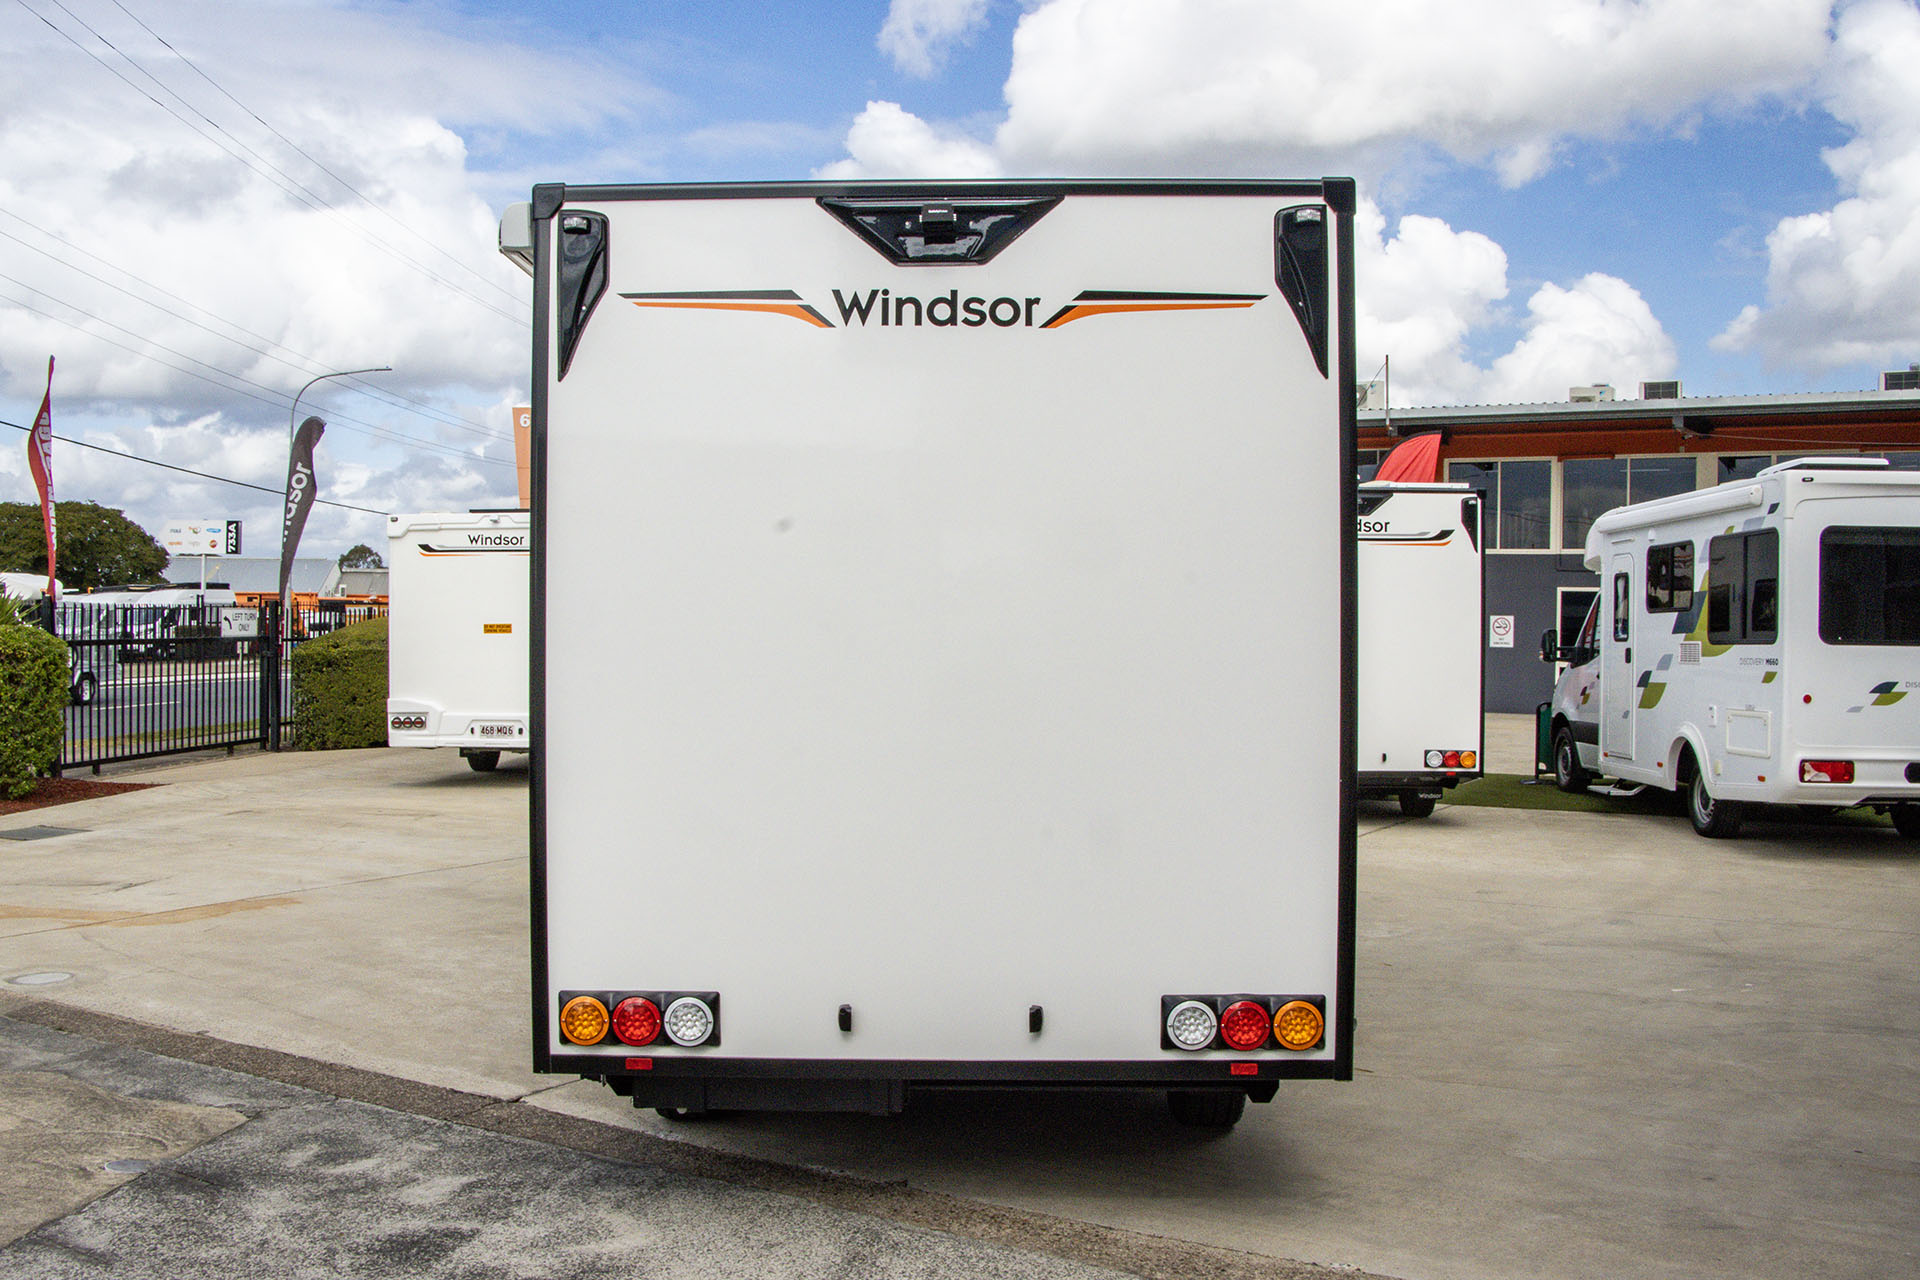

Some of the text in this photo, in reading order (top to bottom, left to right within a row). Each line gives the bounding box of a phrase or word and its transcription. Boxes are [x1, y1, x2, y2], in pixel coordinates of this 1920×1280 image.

[831, 288, 1042, 328] Windsor
[227, 522, 237, 553] 733A
[467, 533, 525, 546] Windsor
[232, 612, 244, 621] LEFT
